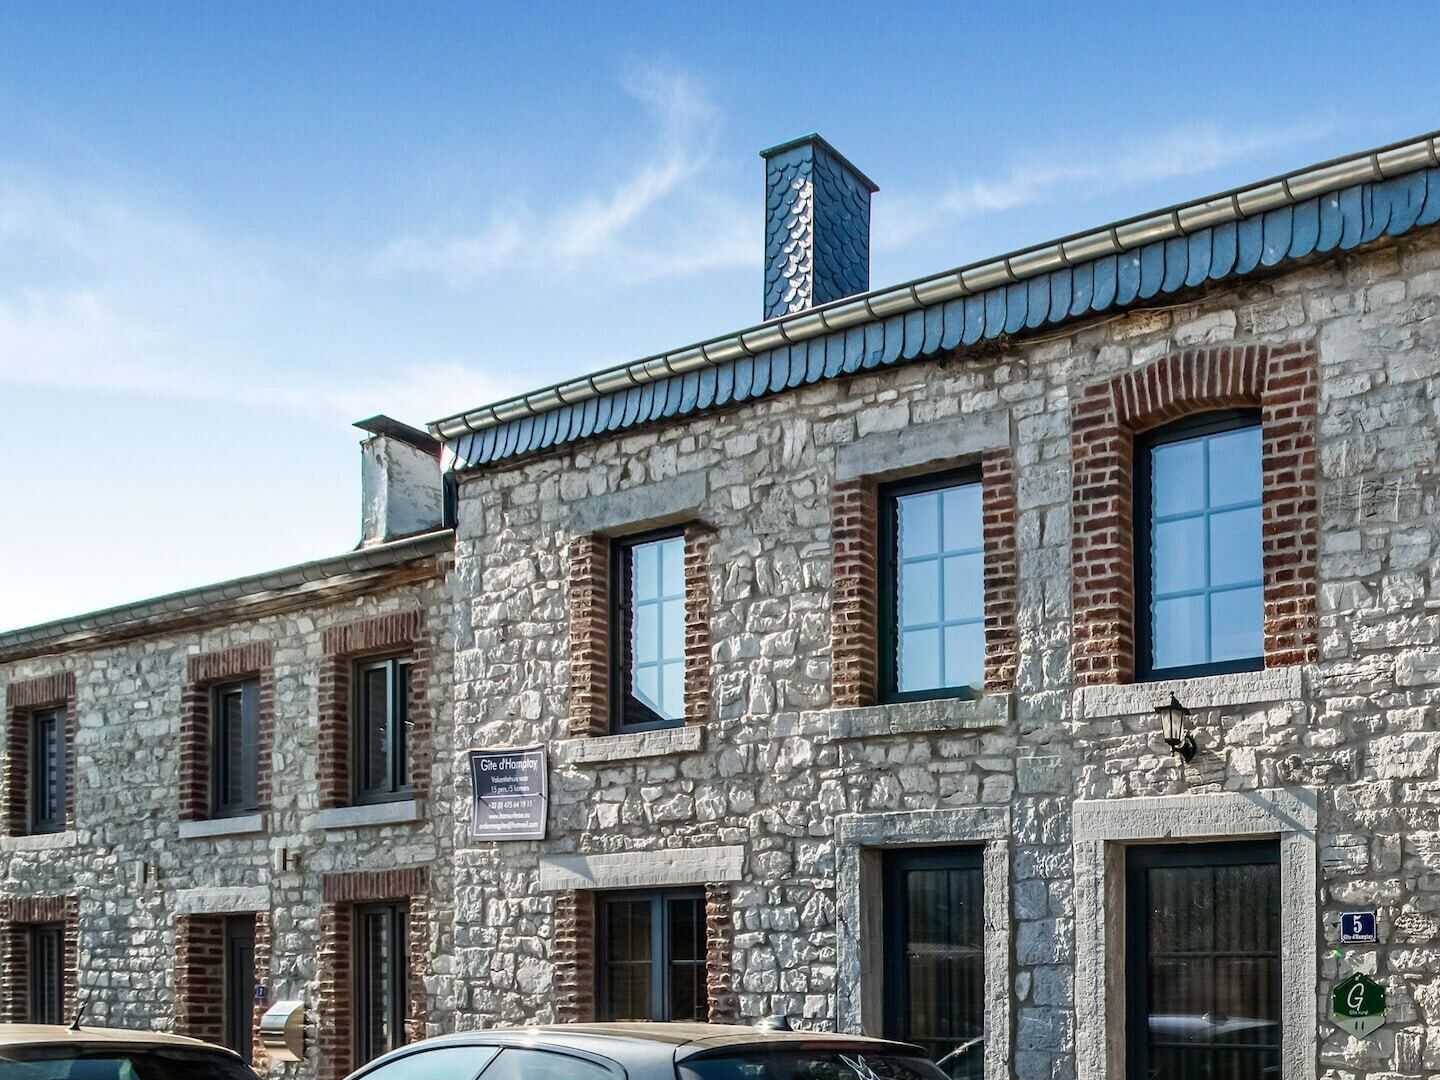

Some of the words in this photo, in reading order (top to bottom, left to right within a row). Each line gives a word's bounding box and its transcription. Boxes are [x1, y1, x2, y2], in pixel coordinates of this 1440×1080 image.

[481, 759, 497, 771] Gîte
[1353, 915, 1363, 933] 5
[1347, 983, 1365, 1011] G
